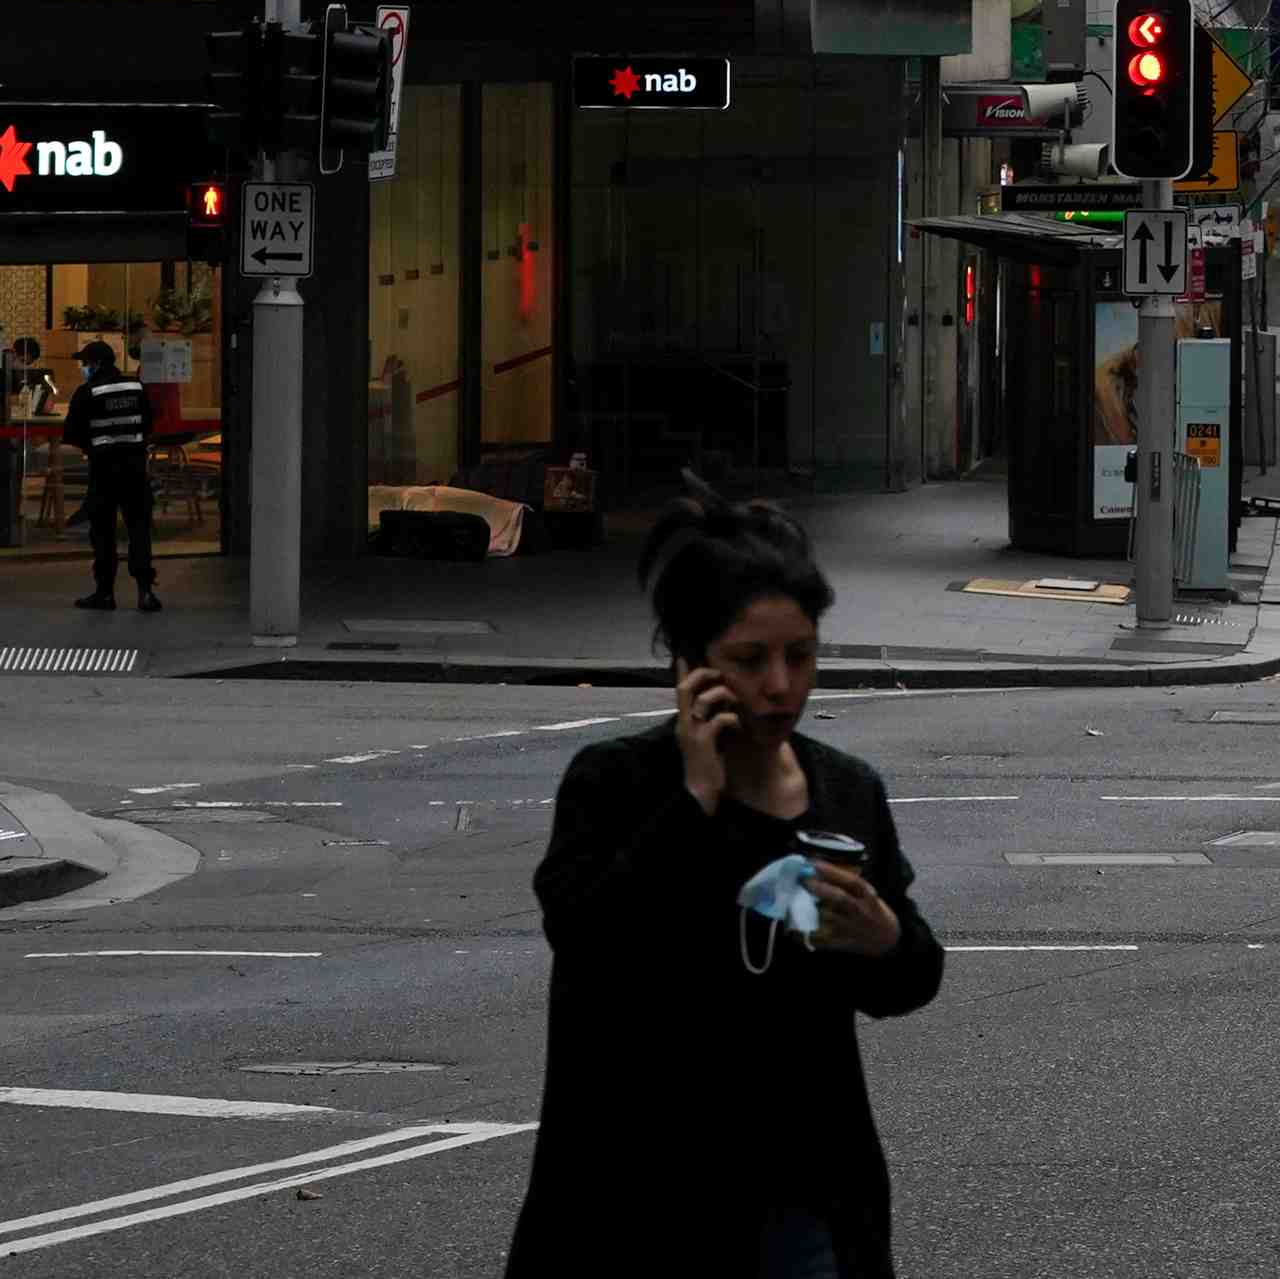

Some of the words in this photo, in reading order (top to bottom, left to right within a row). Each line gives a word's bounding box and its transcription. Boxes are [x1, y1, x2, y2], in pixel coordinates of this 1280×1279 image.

[644, 68, 697, 92] nab
[36, 130, 123, 176] nab
[255, 191, 302, 213] ONE
[250, 220, 305, 241] WAY
